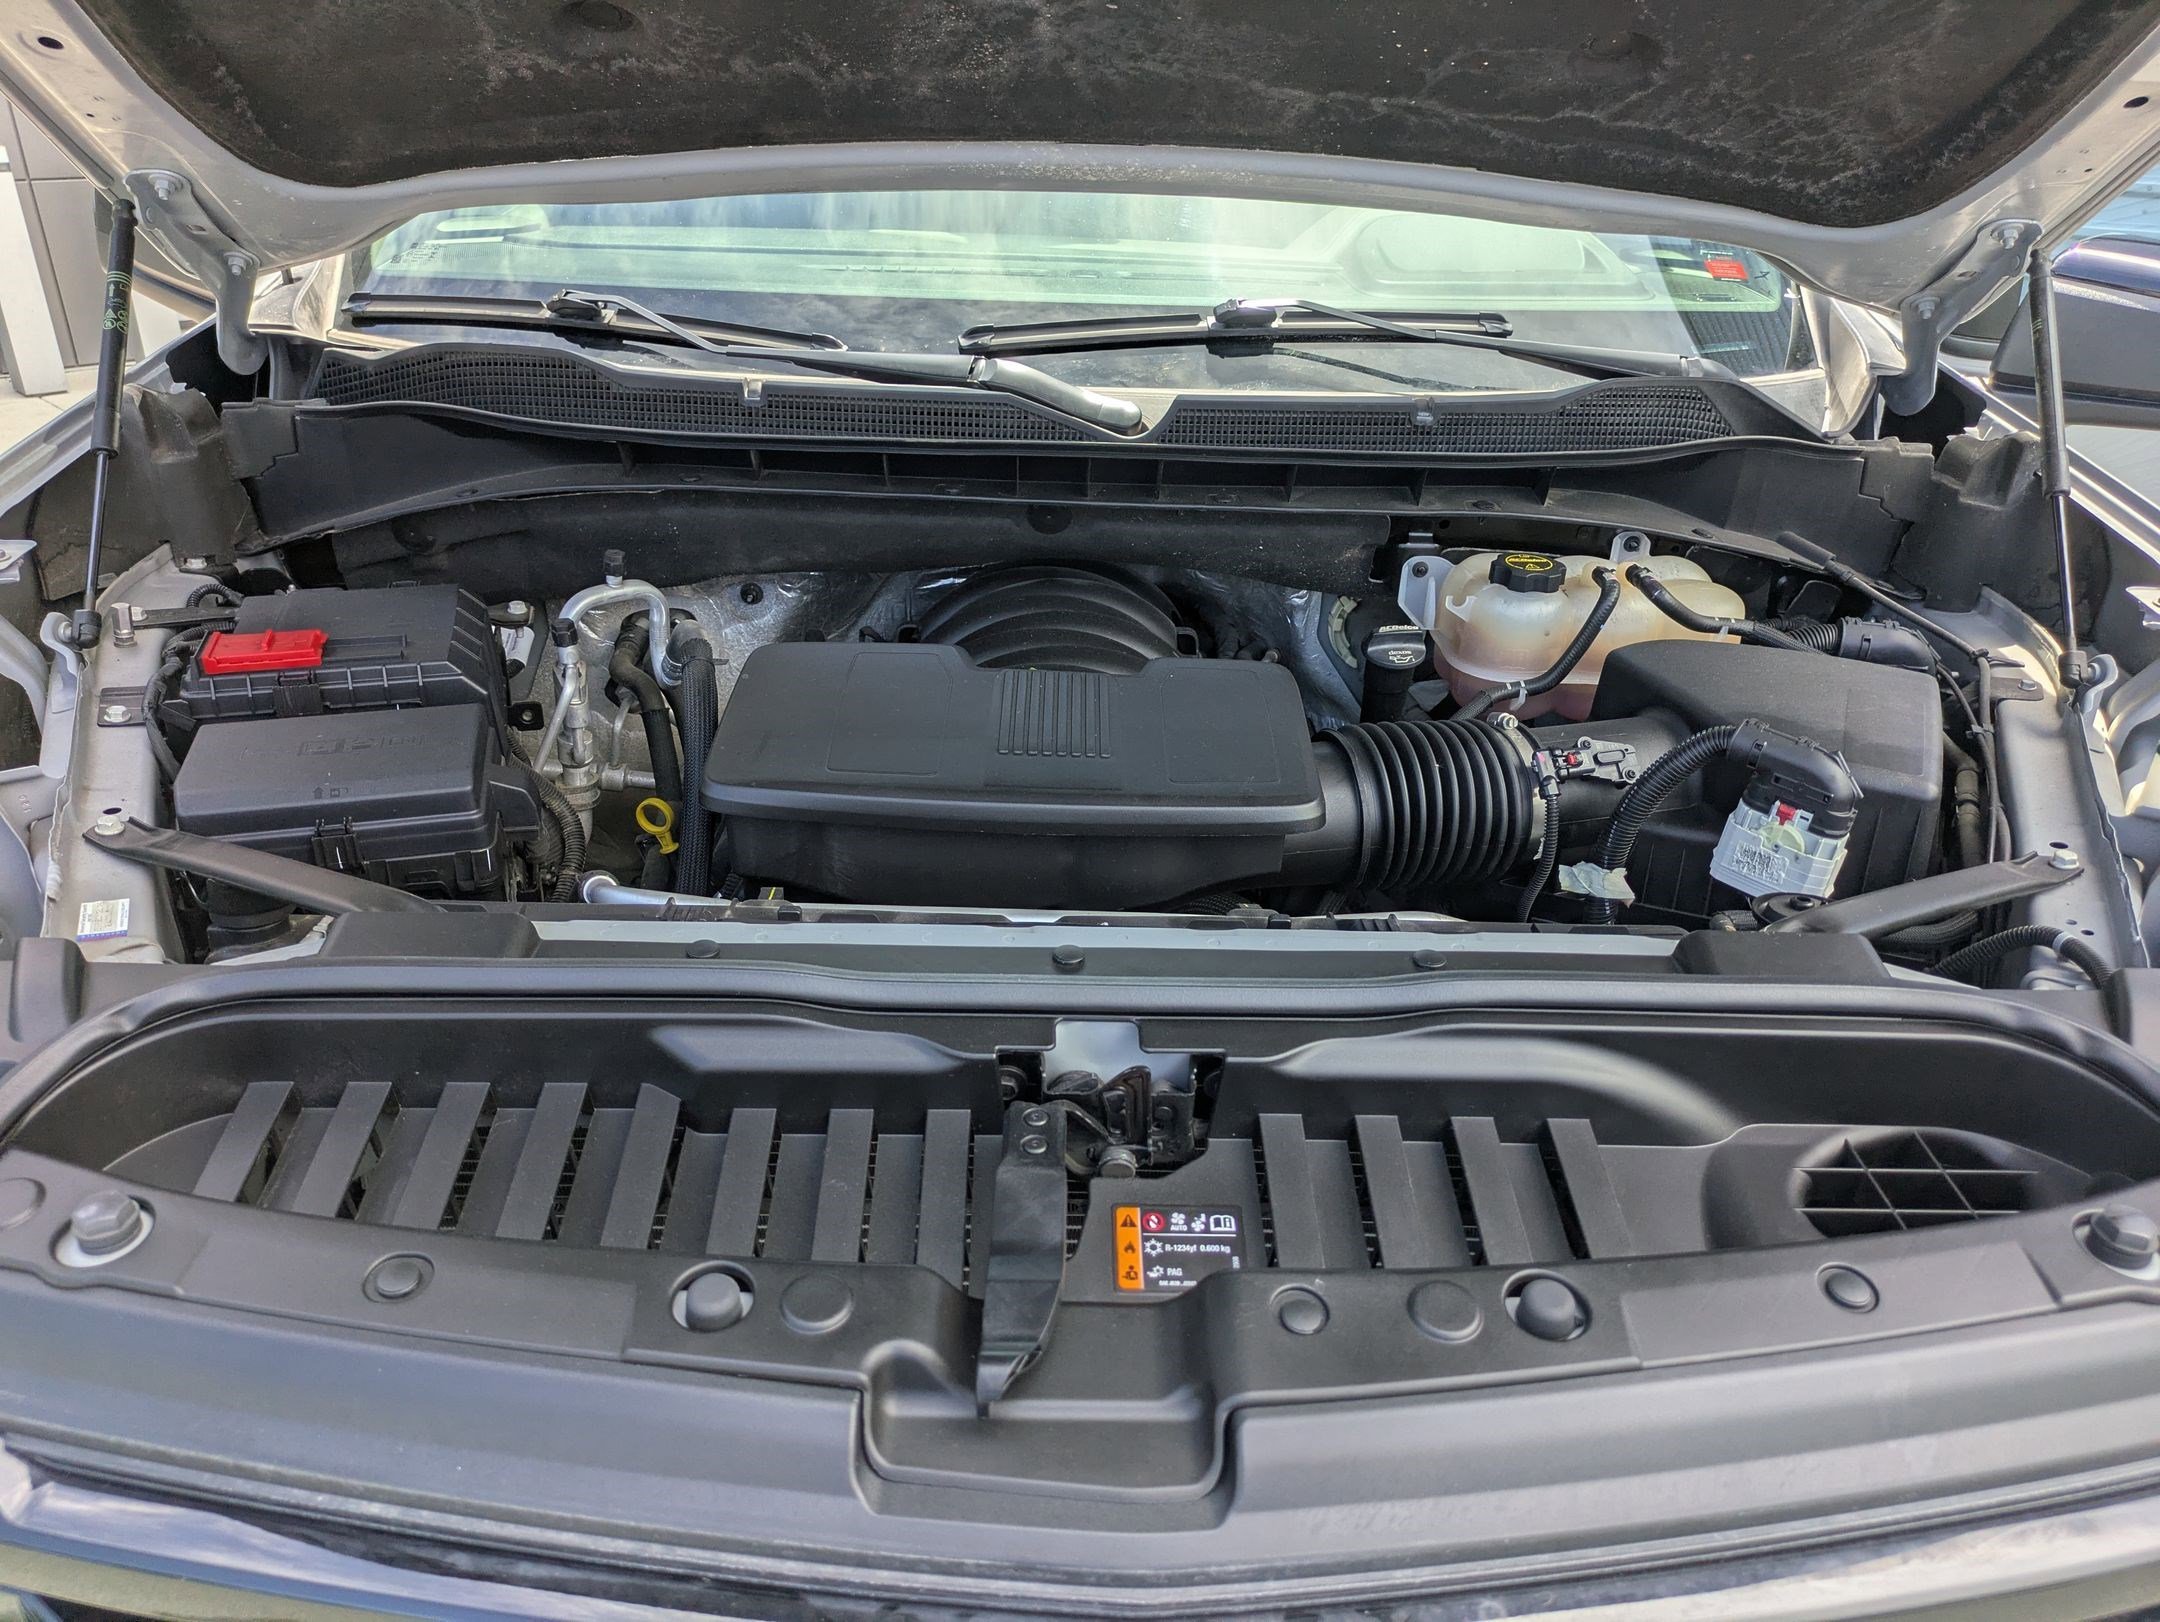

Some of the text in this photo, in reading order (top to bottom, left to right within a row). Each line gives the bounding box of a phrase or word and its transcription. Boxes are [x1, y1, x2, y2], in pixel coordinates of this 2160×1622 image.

[1165, 1243, 1197, 1253] R-1234yf
[1220, 1244, 1231, 1254] kg
[1166, 1267, 1183, 1276] PAG
